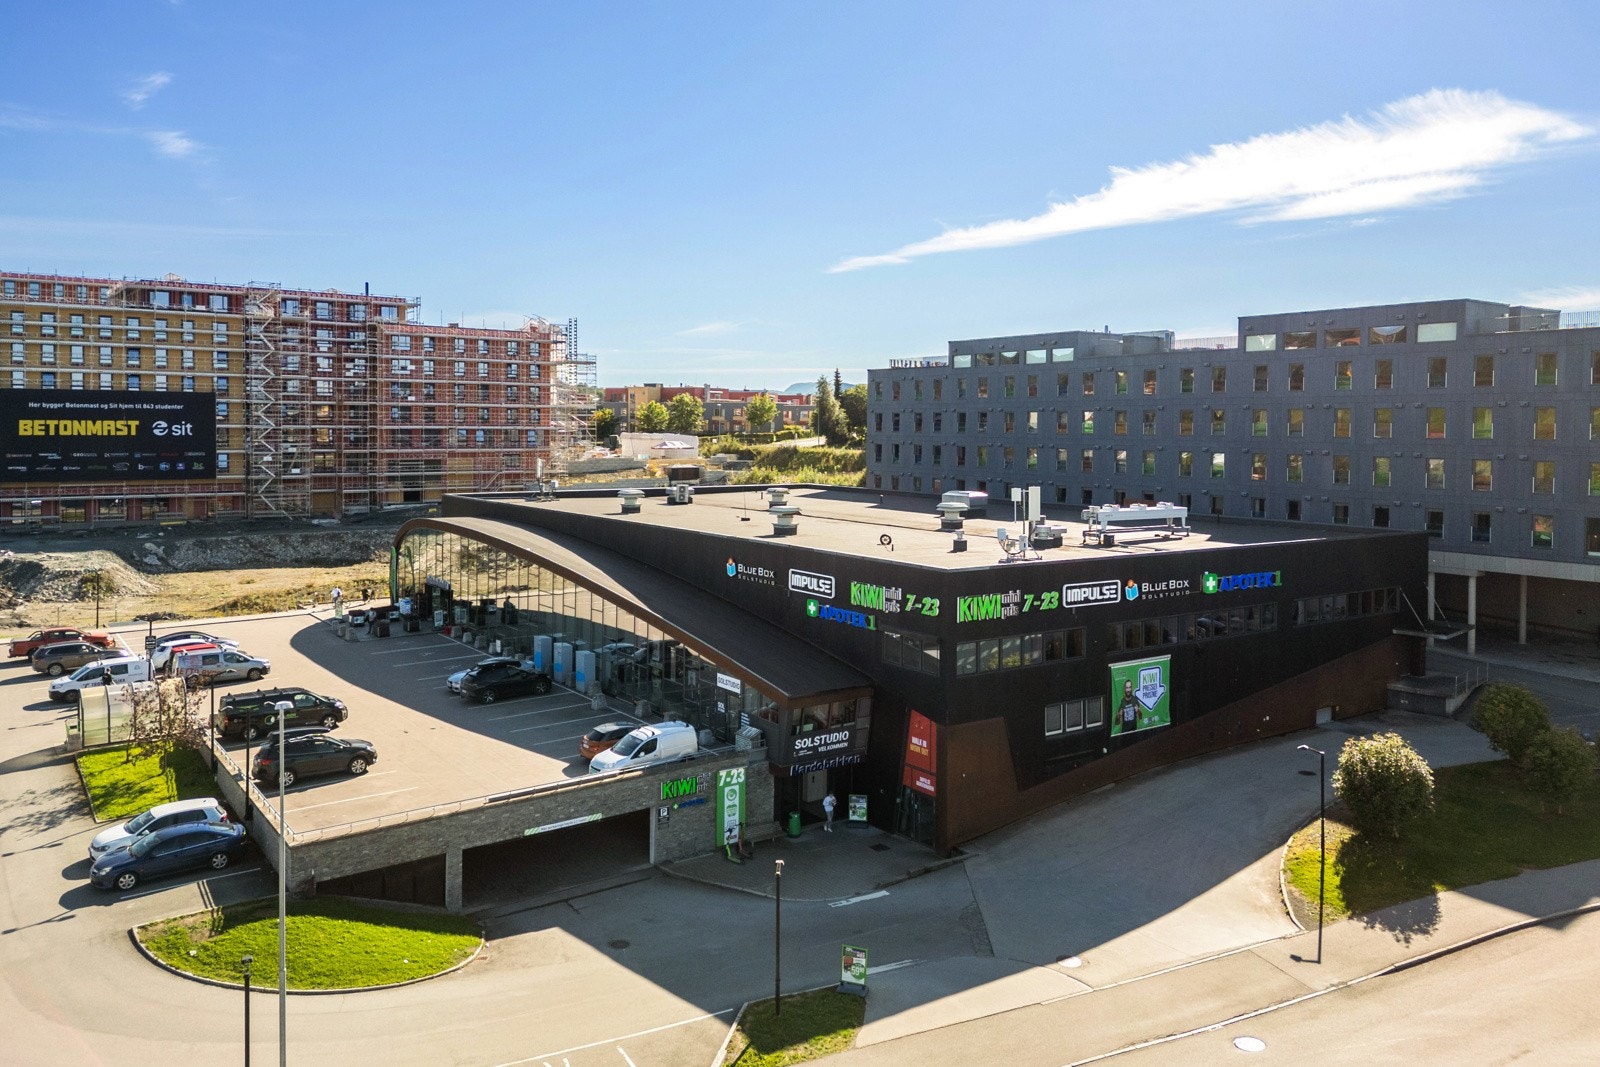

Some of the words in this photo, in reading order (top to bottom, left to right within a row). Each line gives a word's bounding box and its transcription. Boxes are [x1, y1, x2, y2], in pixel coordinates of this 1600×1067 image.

[18, 419, 139, 436] BETONMAST
[172, 421, 193, 436] sit
[738, 574, 775, 586] SOLSTUDIO
[791, 573, 832, 594] IMPULSE
[850, 581, 886, 611] KIWI
[1001, 589, 1021, 604] mini
[1022, 591, 1060, 612] 7-23
[1066, 584, 1117, 603] IMPULSE
[1142, 590, 1190, 600] SOLSTUDIO
[905, 593, 940, 617] 7-23
[957, 594, 1001, 623] KIWI
[820, 605, 868, 629] APOTEK
[1142, 672, 1158, 685] KIWI
[794, 730, 849, 749] SOLSTUDIO
[719, 767, 745, 787] 7-23
[661, 776, 697, 800] KIWI
